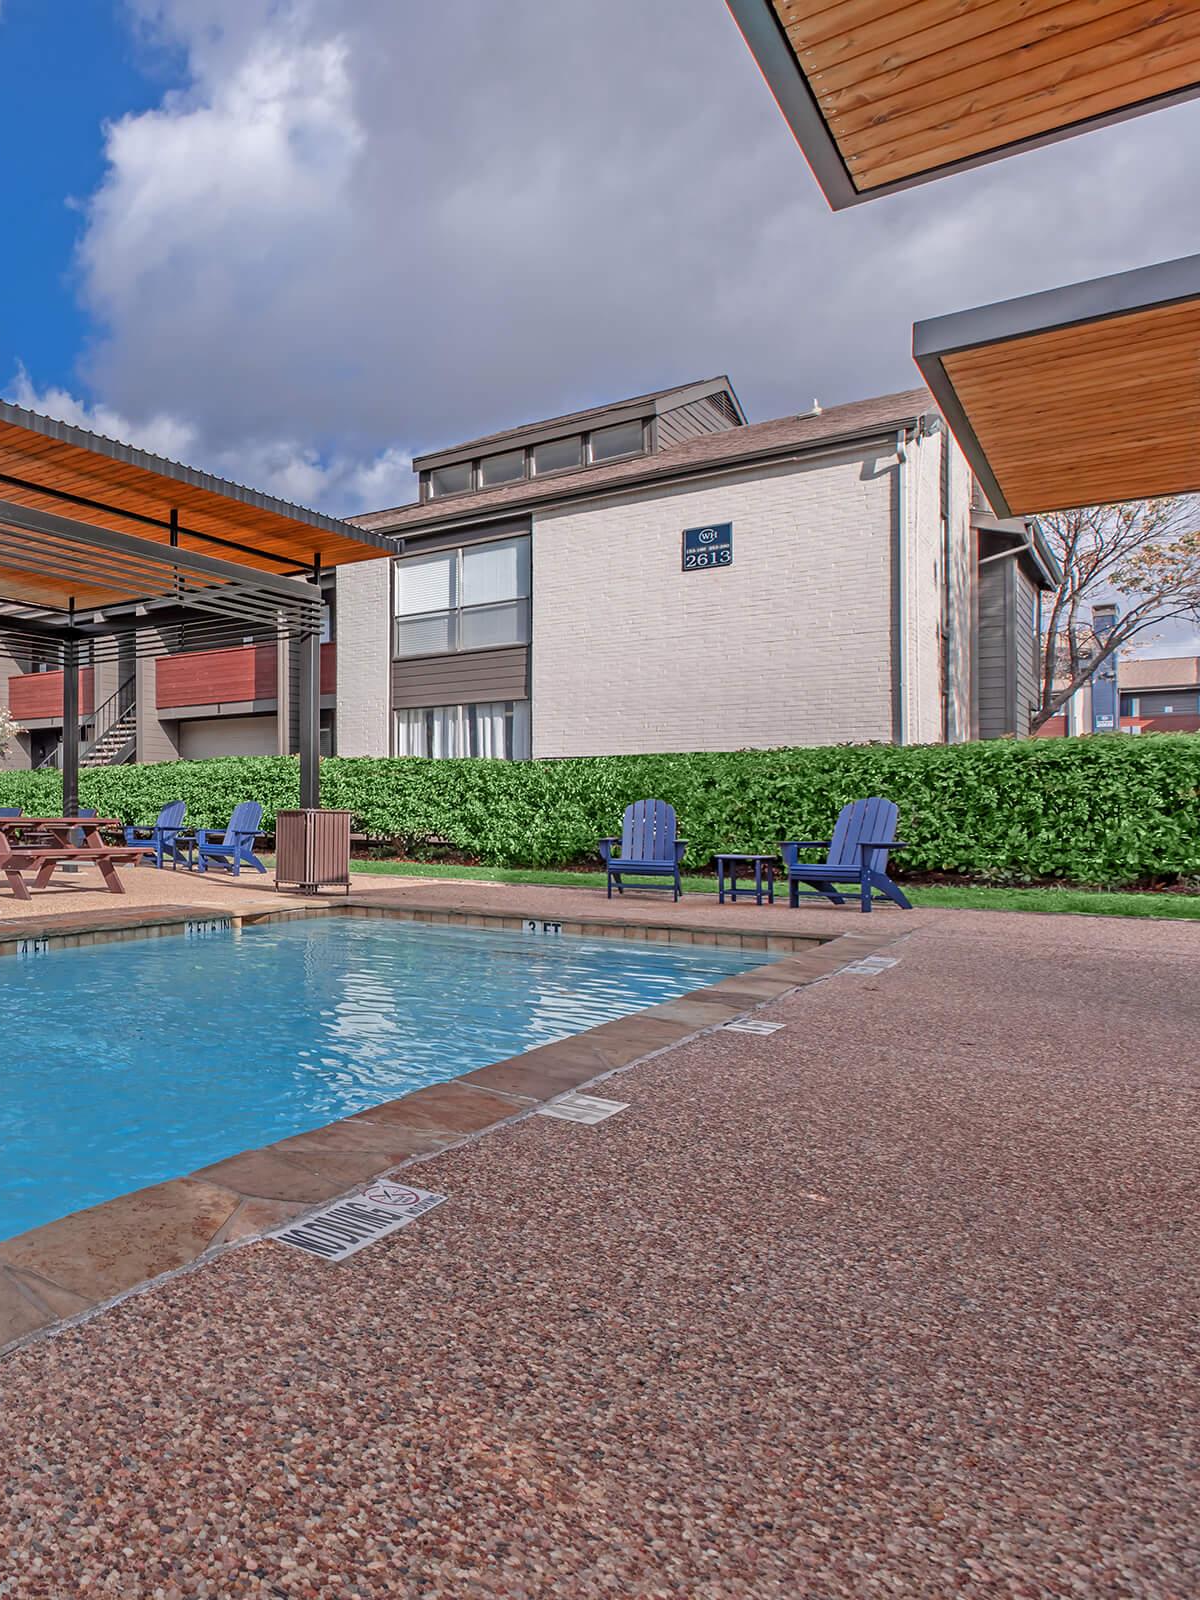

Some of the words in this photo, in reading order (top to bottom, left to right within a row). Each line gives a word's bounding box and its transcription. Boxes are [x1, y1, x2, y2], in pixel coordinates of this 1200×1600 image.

[686, 550, 730, 567] 2613
[543, 922, 562, 933] FT
[34, 938, 49, 953] FT
[302, 1201, 404, 1244] DIVING
[276, 1229, 348, 1257] NO
